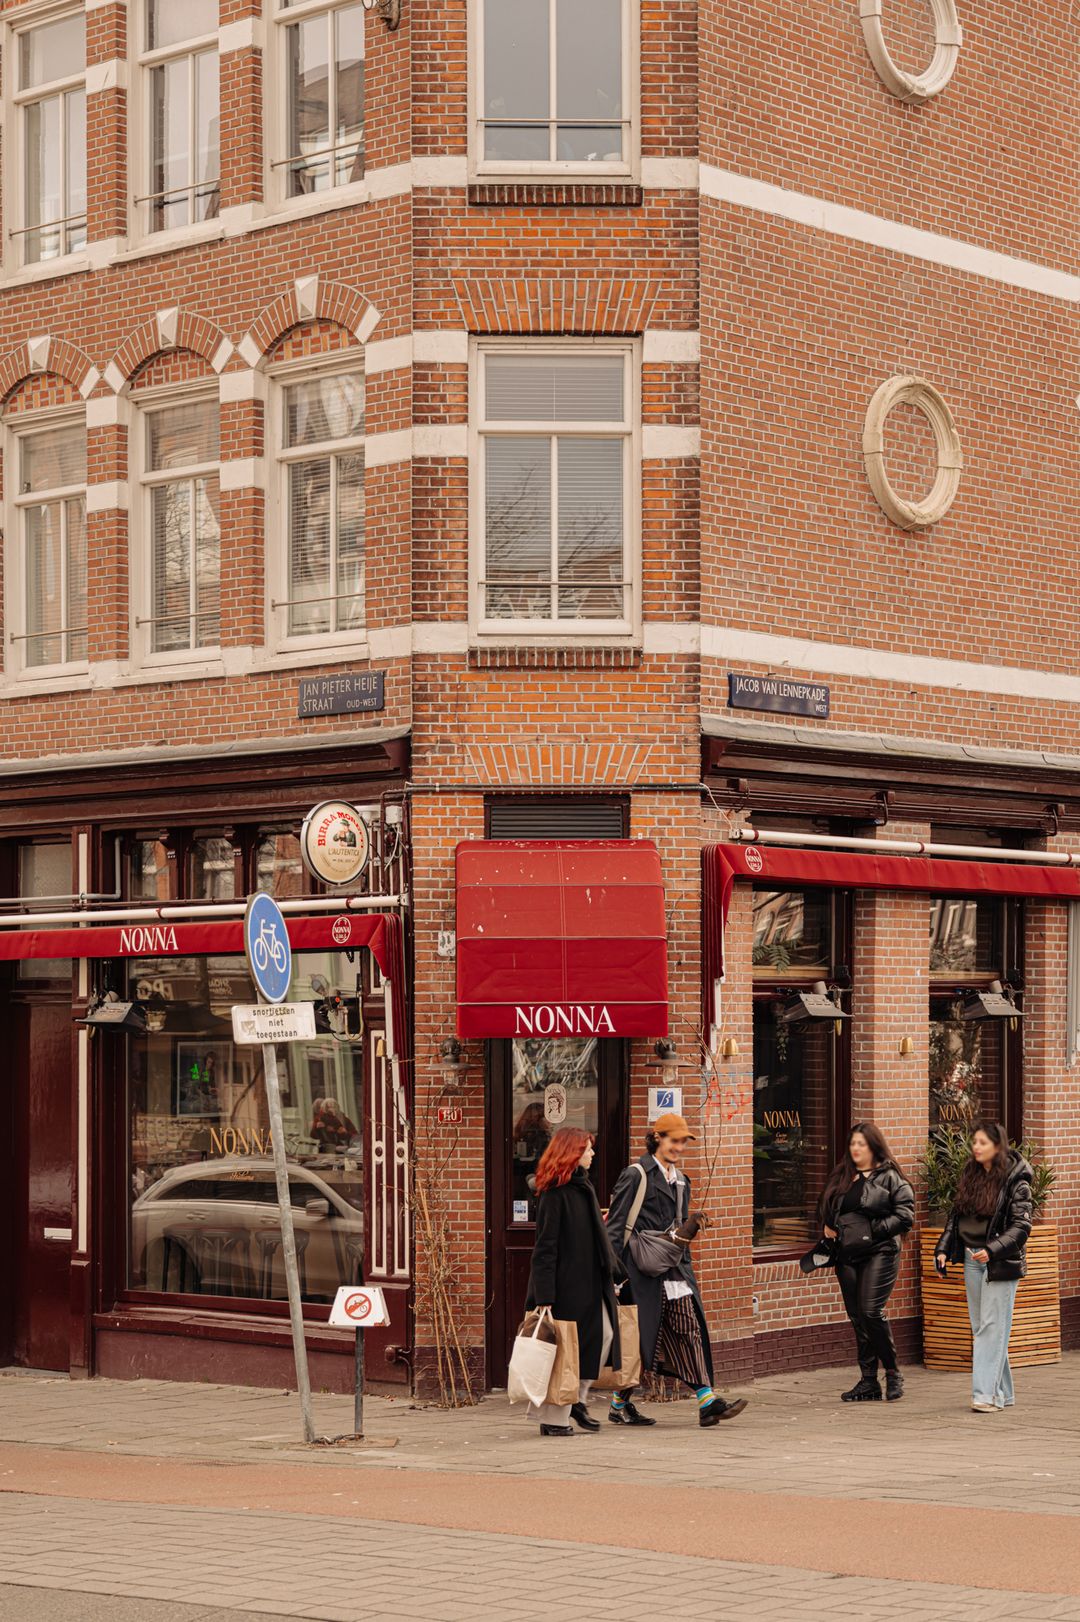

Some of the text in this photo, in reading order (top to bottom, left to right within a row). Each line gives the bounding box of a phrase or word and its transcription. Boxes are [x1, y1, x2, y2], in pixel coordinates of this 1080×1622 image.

[303, 677, 378, 699] JAN PIETER HEIJE
[736, 678, 825, 702] JACOB VAN LENNEPKADE
[303, 697, 377, 713] STRAAT OUD-WEST
[815, 704, 827, 713] WEST
[317, 811, 364, 848] BIRRA MORE
[119, 926, 179, 953] NONNA
[268, 1018, 284, 1027] niet
[514, 1005, 617, 1034] NONNA
[256, 1030, 298, 1040] toegestaan
[763, 1110, 801, 1129] NONNA
